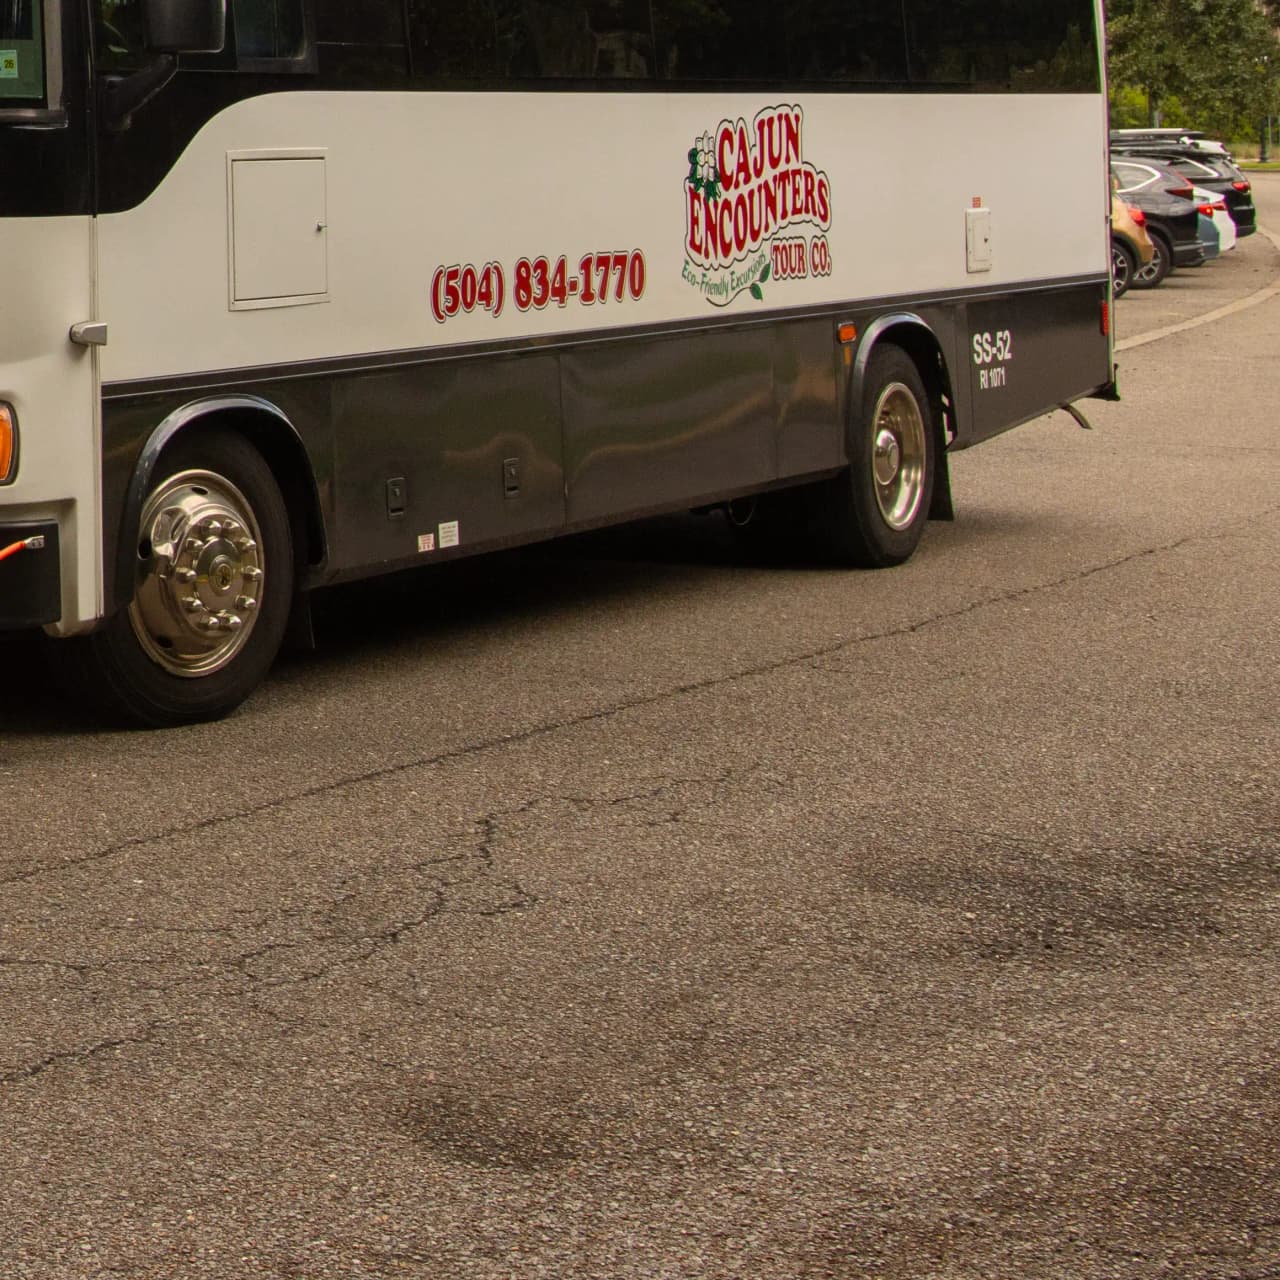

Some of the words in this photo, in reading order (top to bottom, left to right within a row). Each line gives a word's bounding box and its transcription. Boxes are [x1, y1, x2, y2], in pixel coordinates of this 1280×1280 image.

[718, 112, 801, 192] CAJUN
[688, 168, 830, 261] ENCOUNTERS
[772, 242, 806, 277] TOUR
[811, 239, 832, 275] CO.
[431, 262, 505, 323] (504)
[514, 249, 646, 311] 834-1770
[681, 260, 730, 299] Eco-Friendly
[973, 330, 1013, 365] SS-52
[989, 366, 1006, 388] 1071
